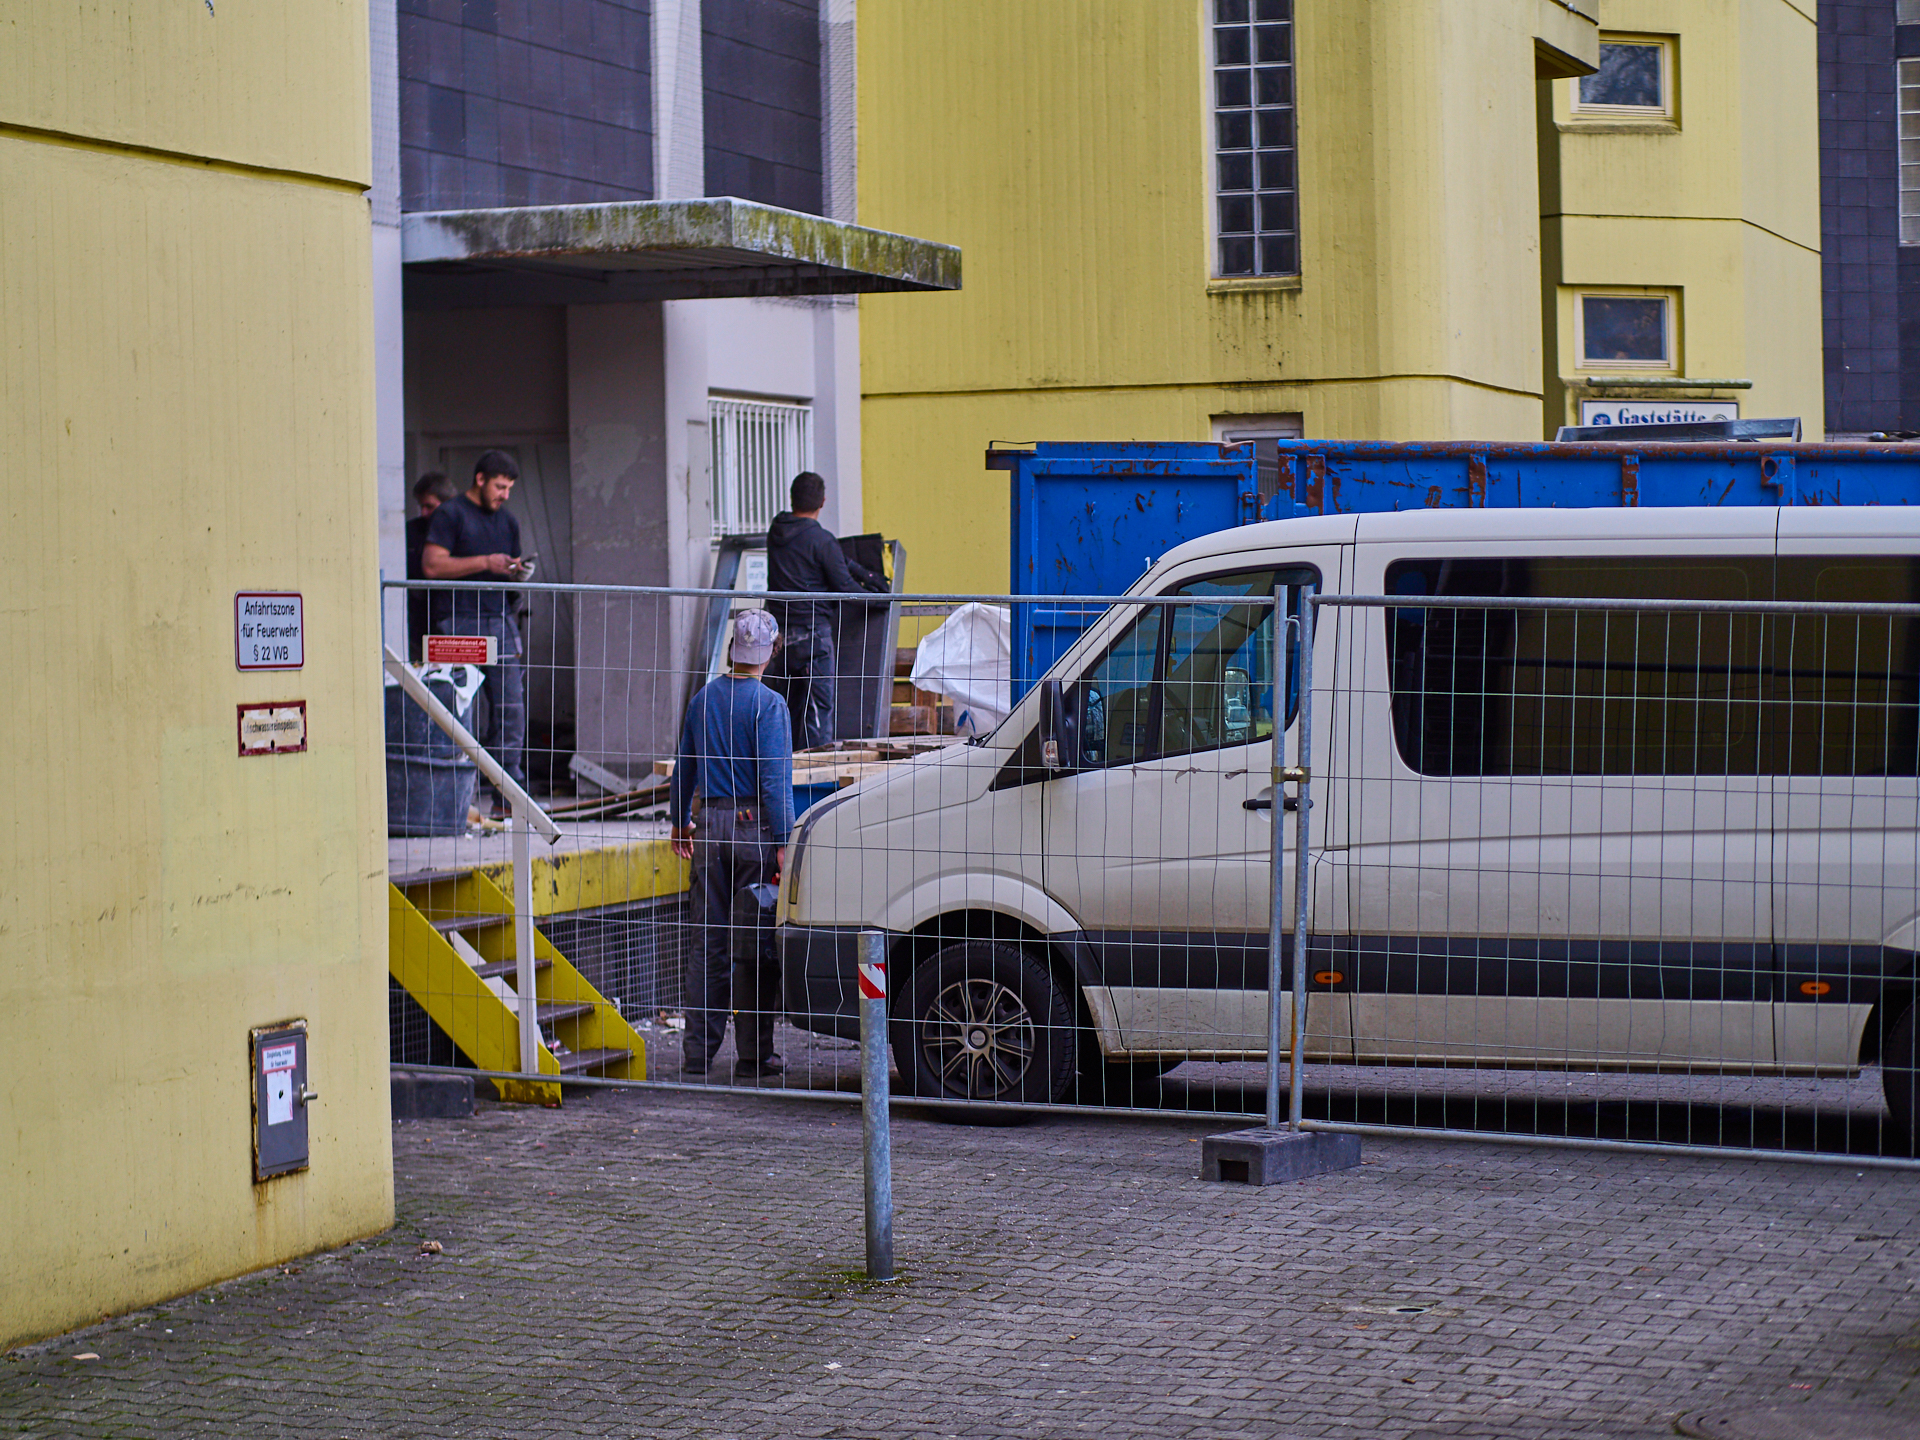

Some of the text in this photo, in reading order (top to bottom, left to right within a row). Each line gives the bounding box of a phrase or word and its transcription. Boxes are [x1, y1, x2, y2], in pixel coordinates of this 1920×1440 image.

[1618, 408, 1706, 425] Gaststätte
[244, 600, 295, 616] Anfahrtszone
[242, 622, 298, 638] für Feuerwehr
[253, 644, 259, 661] §
[261, 646, 271, 661] 22
